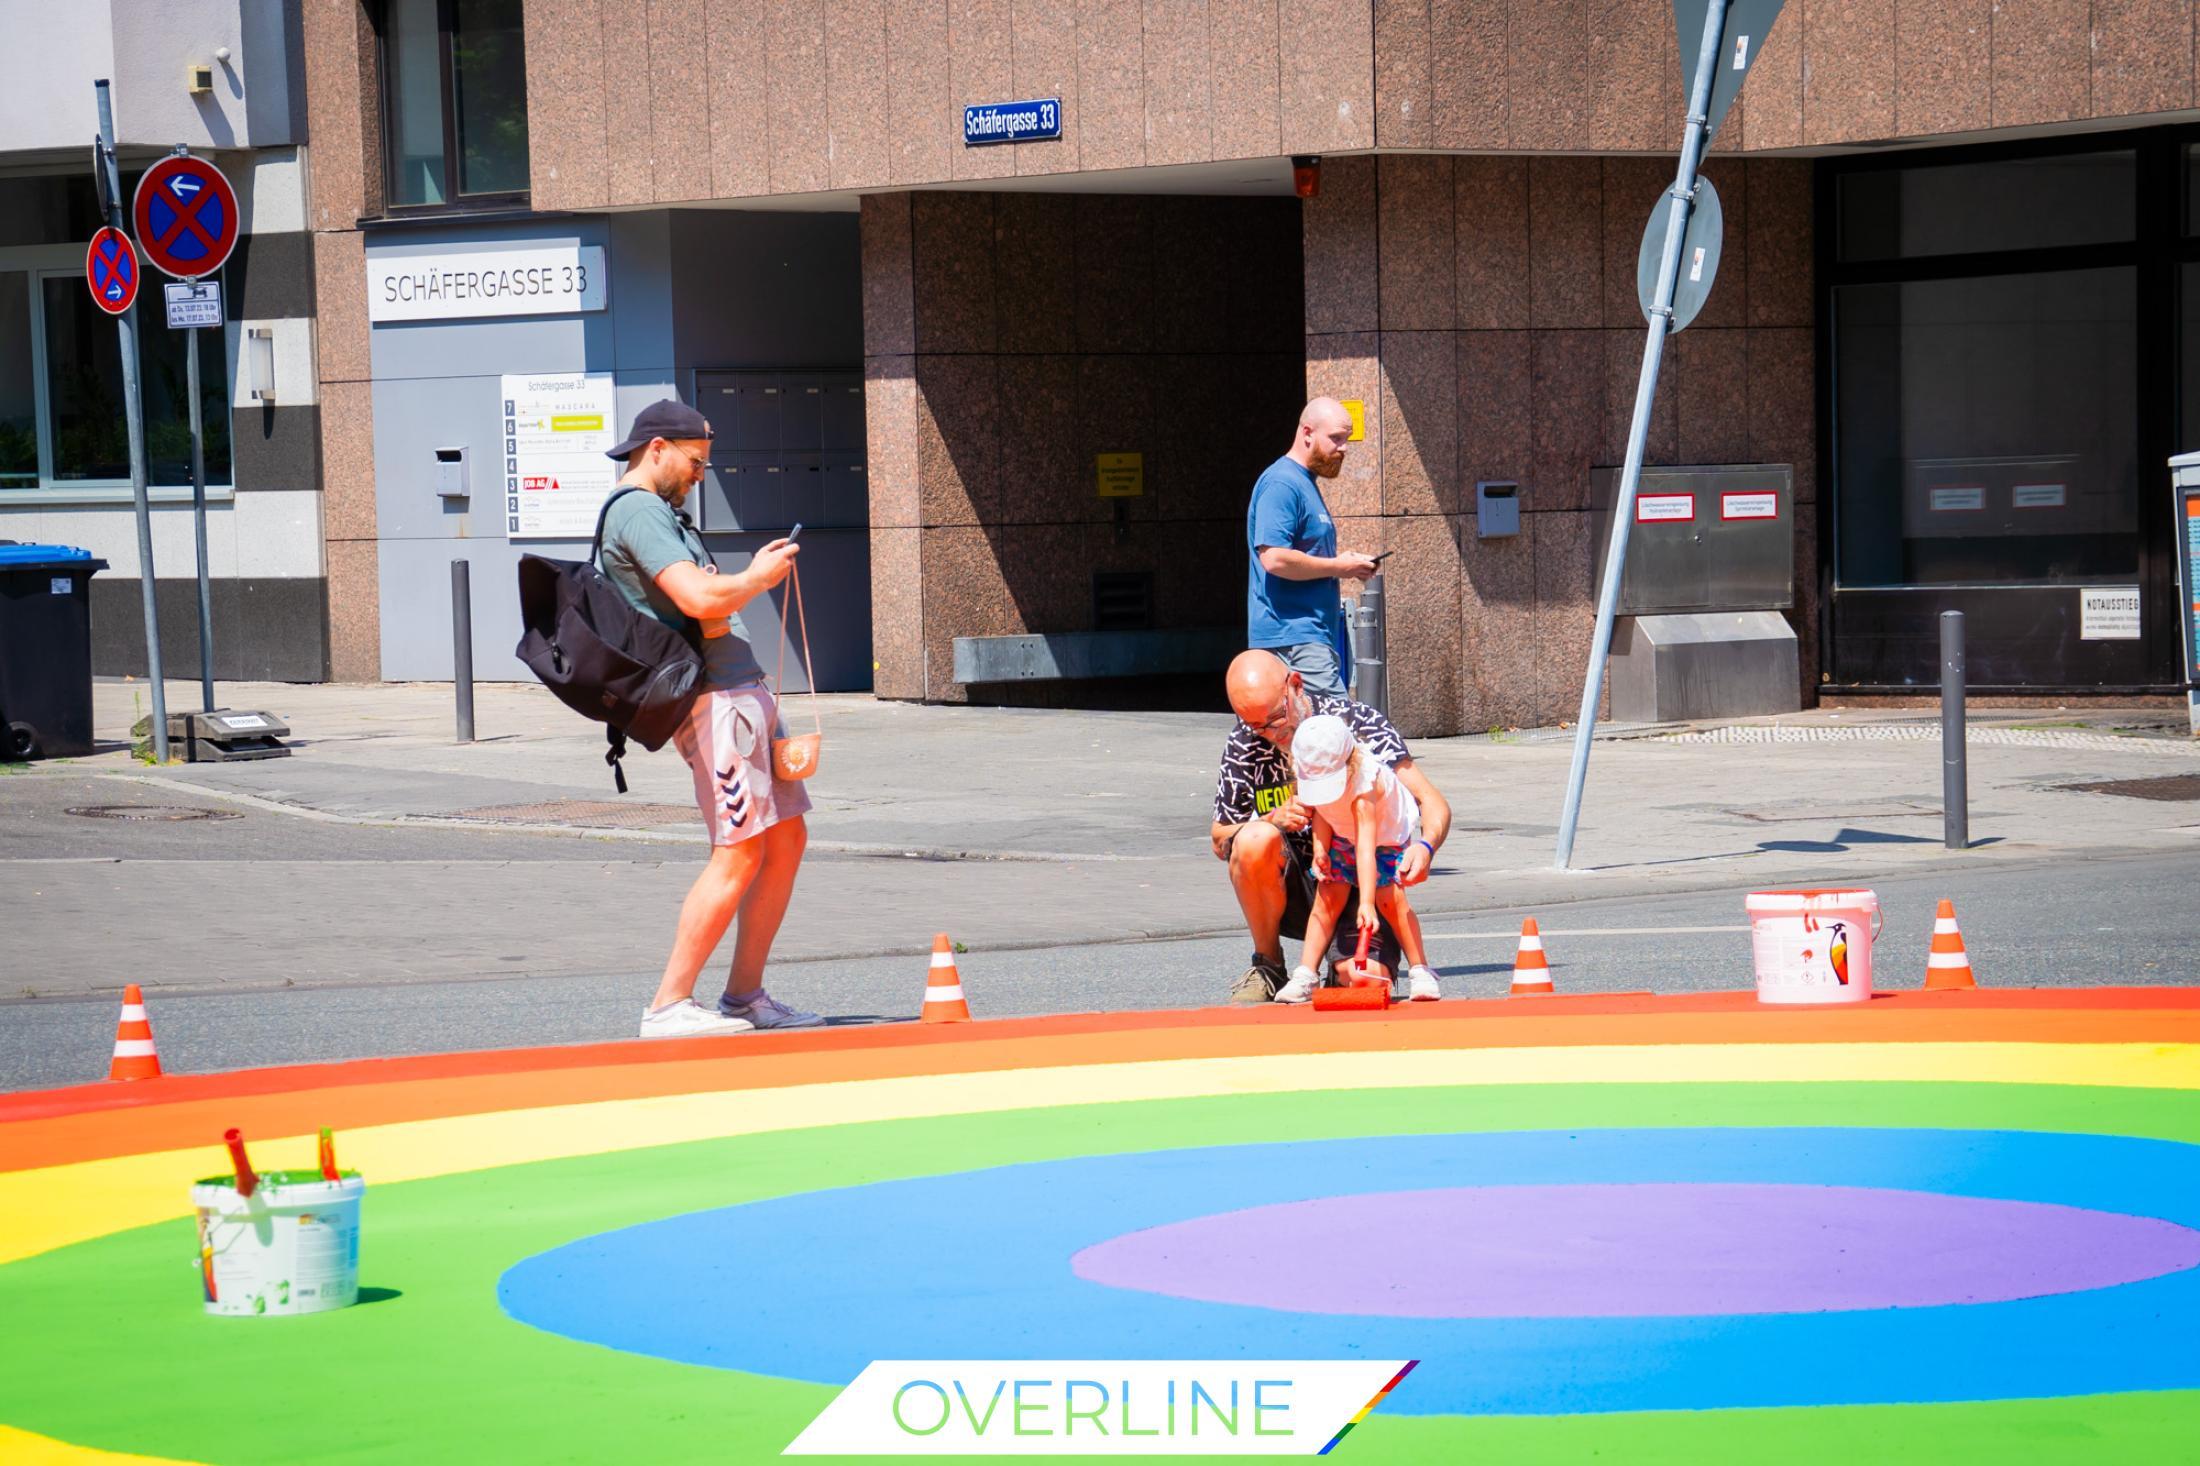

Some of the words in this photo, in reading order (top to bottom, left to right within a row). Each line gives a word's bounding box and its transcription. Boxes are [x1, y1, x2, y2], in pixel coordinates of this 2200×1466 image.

[966, 109, 1038, 138] Schäfergasse
[1040, 103, 1055, 129] 33
[384, 267, 553, 302] SCHÄFERGASSE
[561, 265, 587, 293] 33
[528, 381, 575, 393] Schäfergasse
[576, 379, 585, 391] 33
[506, 403, 513, 412] 7
[507, 423, 513, 432] 6
[507, 442, 515, 452] 5
[508, 461, 515, 471] 4
[509, 481, 515, 490] 3
[524, 480, 535, 489] JOB
[536, 479, 546, 488] AG
[510, 500, 517, 510] 2
[510, 520, 517, 529] 1
[2087, 598, 2139, 610] NOTAUSSTIEG
